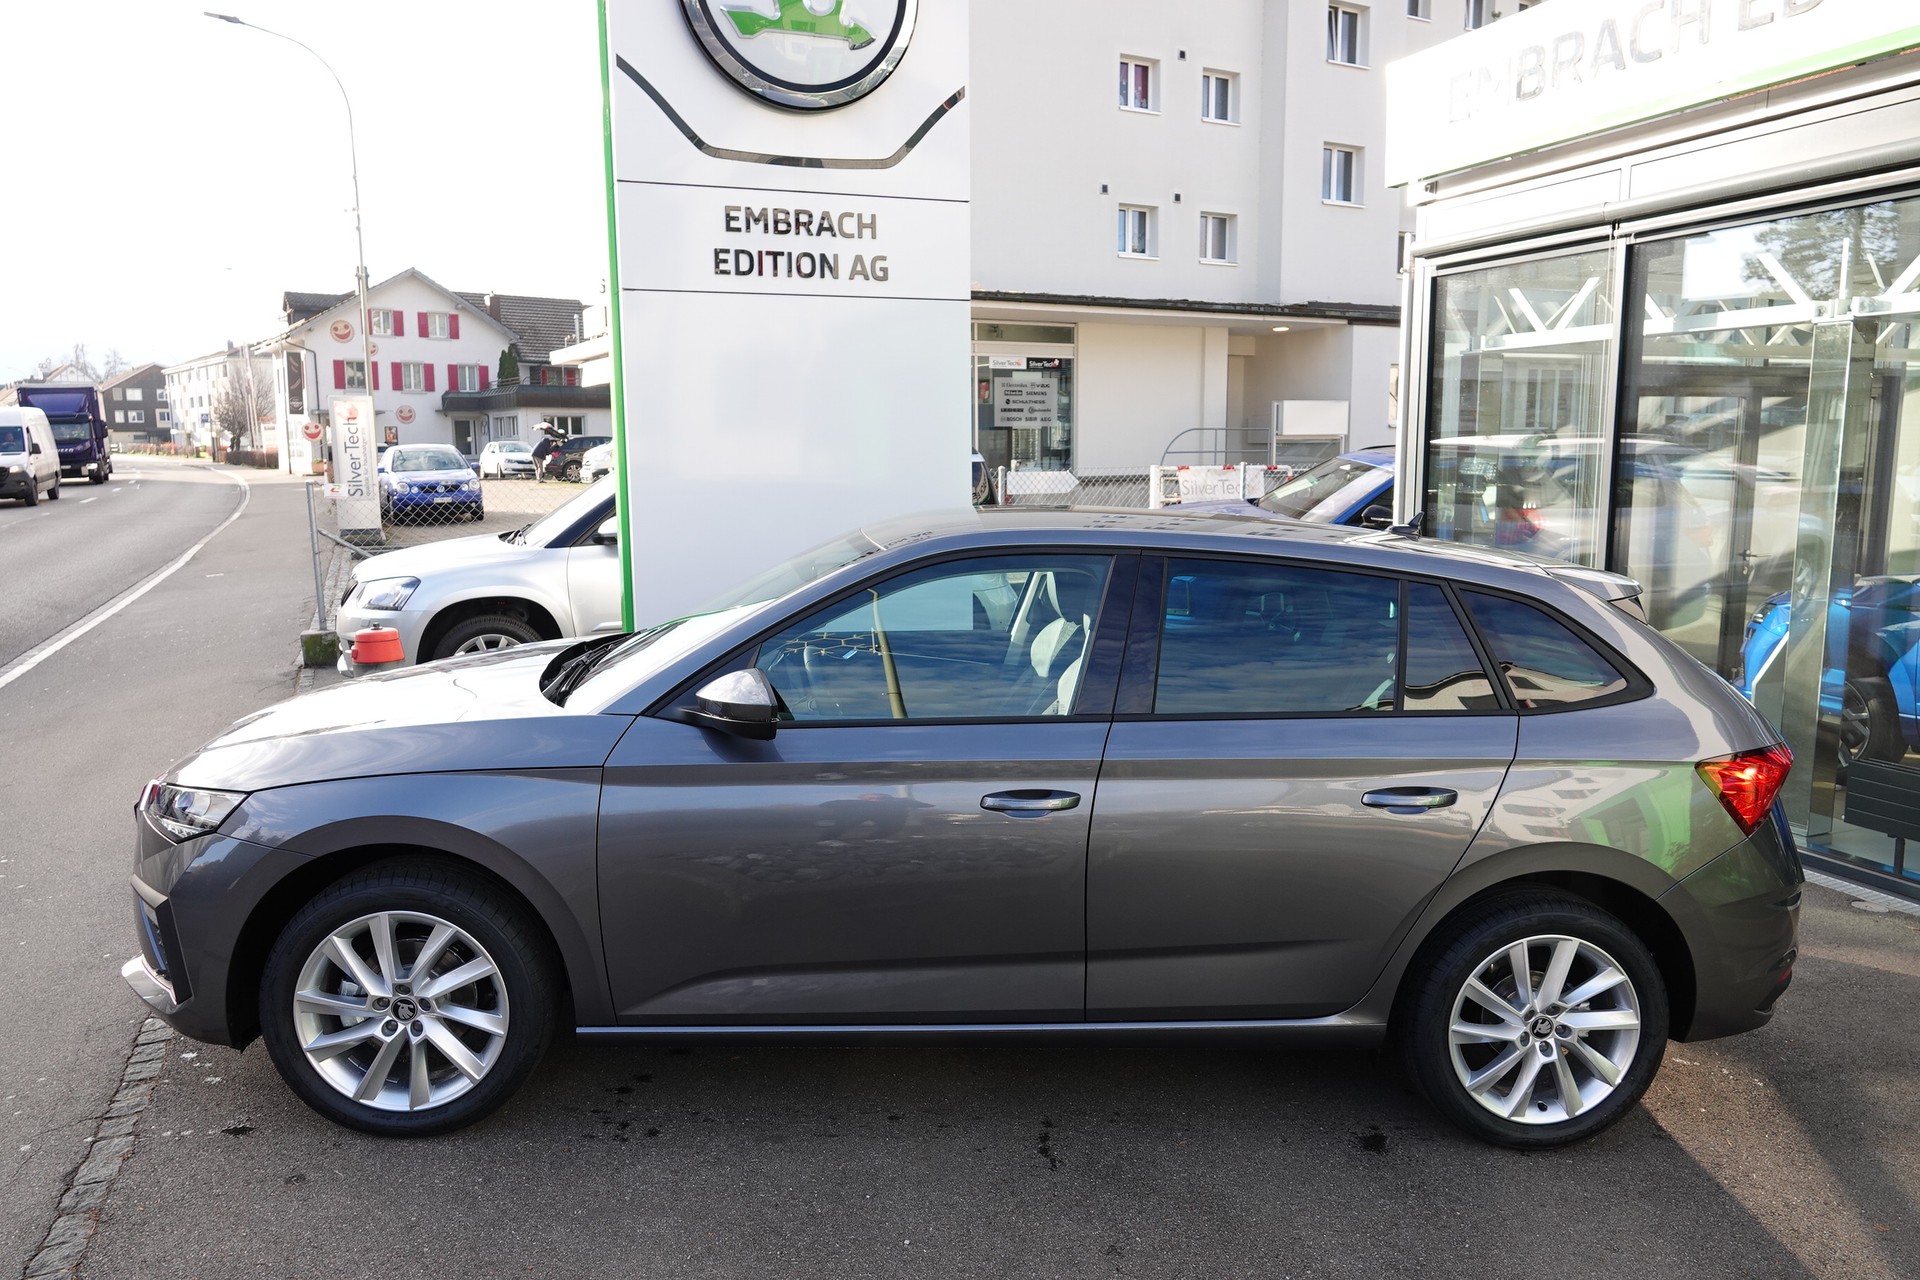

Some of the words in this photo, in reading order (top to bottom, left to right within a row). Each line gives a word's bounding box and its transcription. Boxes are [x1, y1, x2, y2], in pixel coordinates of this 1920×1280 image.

[724, 205, 877, 240] EMBRACH
[714, 248, 839, 280] EDITION
[848, 254, 889, 282] AG
